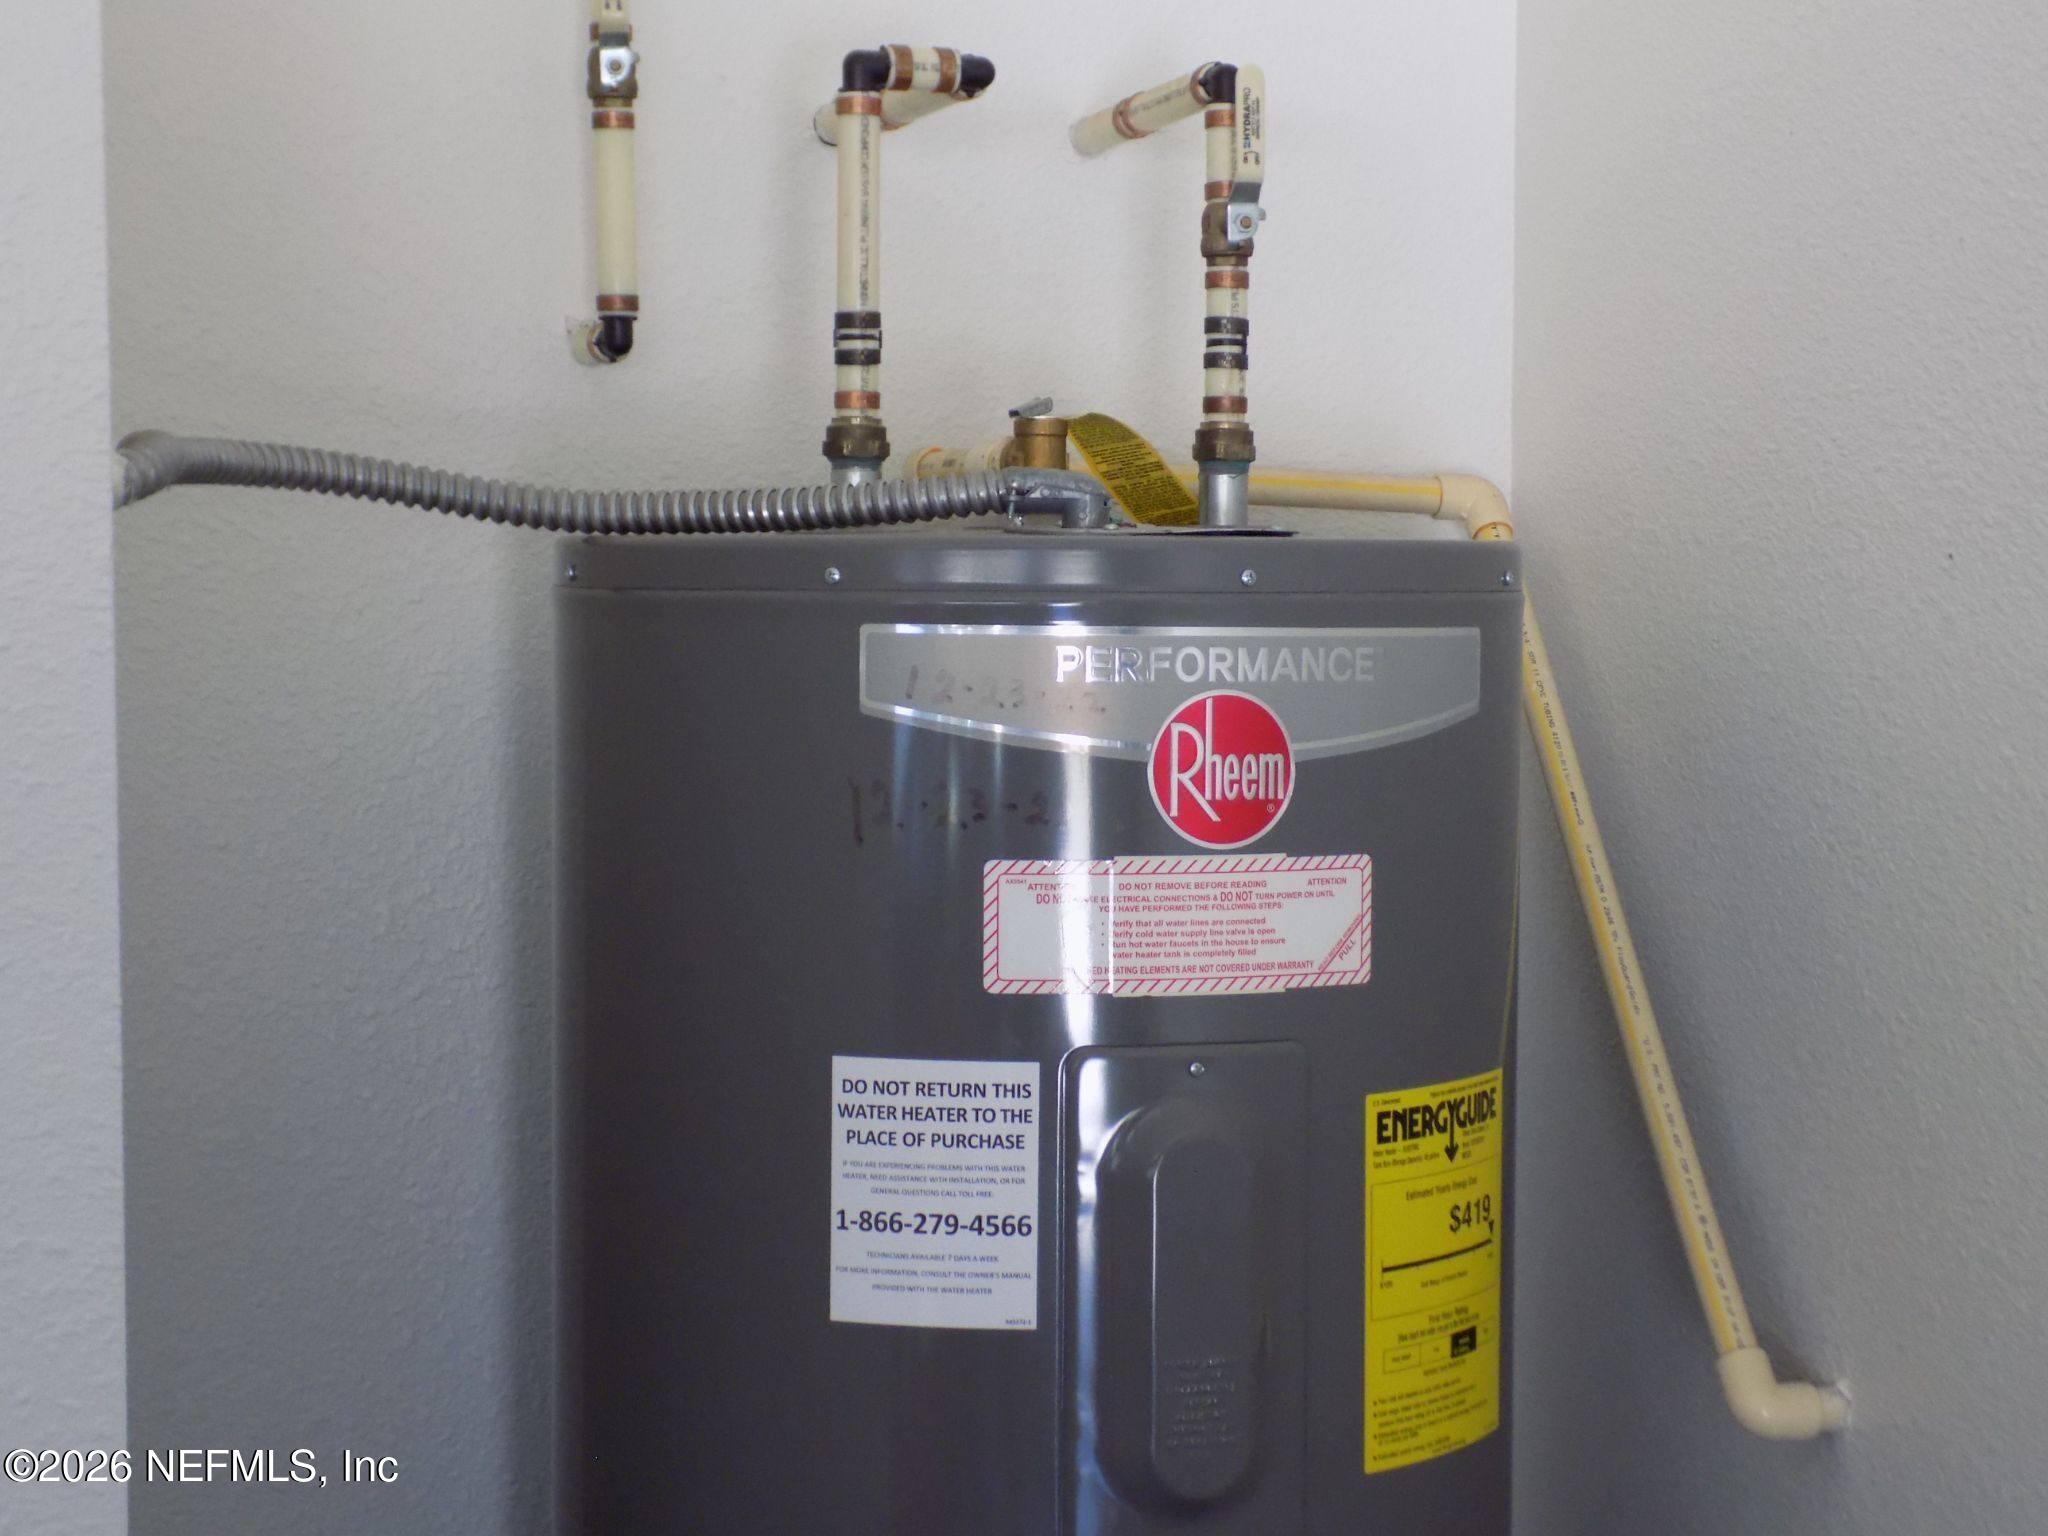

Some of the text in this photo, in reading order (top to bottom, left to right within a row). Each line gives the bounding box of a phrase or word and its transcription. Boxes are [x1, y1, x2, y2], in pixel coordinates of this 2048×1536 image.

[1243, 87, 1251, 140] HYDRAPRO
[1055, 646, 1375, 683] PERFORMANCE
[1544, 702, 1556, 729] TUBING
[1169, 696, 1284, 823] Rheem
[1118, 883, 1131, 891] DO
[1155, 882, 1192, 890] REMOVE
[1194, 881, 1229, 890] BEFORE
[1230, 880, 1267, 889] READING
[1307, 877, 1347, 886] ATTENTION
[1036, 894, 1050, 905] DO
[1153, 895, 1211, 903] CONNECTIONS
[1220, 891, 1233, 902] DO
[1235, 890, 1253, 902] NOT
[1255, 892, 1275, 900] TURN
[1276, 892, 1303, 900] POWER
[1304, 891, 1314, 899] ON
[1315, 890, 1335, 898] UNTIL
[1142, 904, 1192, 912] PERFORMED
[1211, 903, 1257, 911] FOLLOWING
[1135, 919, 1152, 927] that
[1153, 919, 1164, 927] all
[1165, 919, 1188, 927] water
[1226, 917, 1266, 925] connected
[1134, 930, 1154, 938] cold
[1180, 929, 1208, 938] supply
[1209, 928, 1224, 936] line
[1247, 927, 1255, 935] is
[1256, 928, 1276, 936] open
[1168, 939, 1200, 948] faucets
[1201, 938, 1209, 946] in
[1210, 938, 1223, 946] the
[1225, 938, 1249, 946] house
[1260, 937, 1286, 945] ensure
[1163, 950, 1181, 958] tank
[1192, 949, 1235, 959] completely
[1237, 948, 1257, 956] filled
[1338, 939, 1356, 961] PULL
[1140, 965, 1180, 974] ELEMENTS
[1181, 965, 1197, 973] ARE
[1198, 964, 1214, 973] NOT
[1215, 963, 1251, 972] COVERED
[1251, 962, 1276, 971] UNDER
[1277, 960, 1314, 970] WARRANTY
[842, 1079, 1032, 1099] DO NOT RETURN THIS
[837, 1103, 1033, 1124] WATER HEATER TO THE
[1376, 1086, 1497, 1145] ENERGYGUIDE
[846, 1129, 1026, 1150] PLACE OF PURCHASE
[849, 1160, 863, 1168] YOU
[864, 1161, 877, 1169] ARE
[878, 1161, 926, 1171] EXPERIENCING
[927, 1163, 963, 1172] PROBLEMS
[964, 1164, 983, 1172] WITH
[984, 1164, 1000, 1172] THIS
[1000, 1165, 1026, 1173] WATER
[870, 1173, 887, 1181] NEED
[888, 1174, 928, 1182] ASSISTANCE
[929, 1175, 947, 1183] WITH
[948, 1176, 999, 1185] INSTALLATION,
[999, 1177, 1011, 1185] OR
[870, 1187, 901, 1196] GENERAL
[901, 1188, 940, 1197] QUESTIONS
[941, 1189, 957, 1197] CALL
[1449, 1193, 1491, 1234] $419
[835, 1209, 1033, 1237] 1-866-279-4566
[866, 1251, 909, 1261] TECHNICIANS
[909, 1252, 945, 1261] AVAILABLE
[953, 1254, 971, 1262] DAYS
[979, 1255, 999, 1263] WEEK
[920, 1270, 952, 1278] CONSULT
[953, 1271, 966, 1279] THE
[967, 1271, 1000, 1280] OWNER'S
[1001, 1272, 1032, 1280] MANUAL
[872, 1284, 906, 1293] PROVIDED
[907, 1285, 925, 1293] WITH
[927, 1286, 939, 1294] THE
[966, 1287, 993, 1295] HEATER
